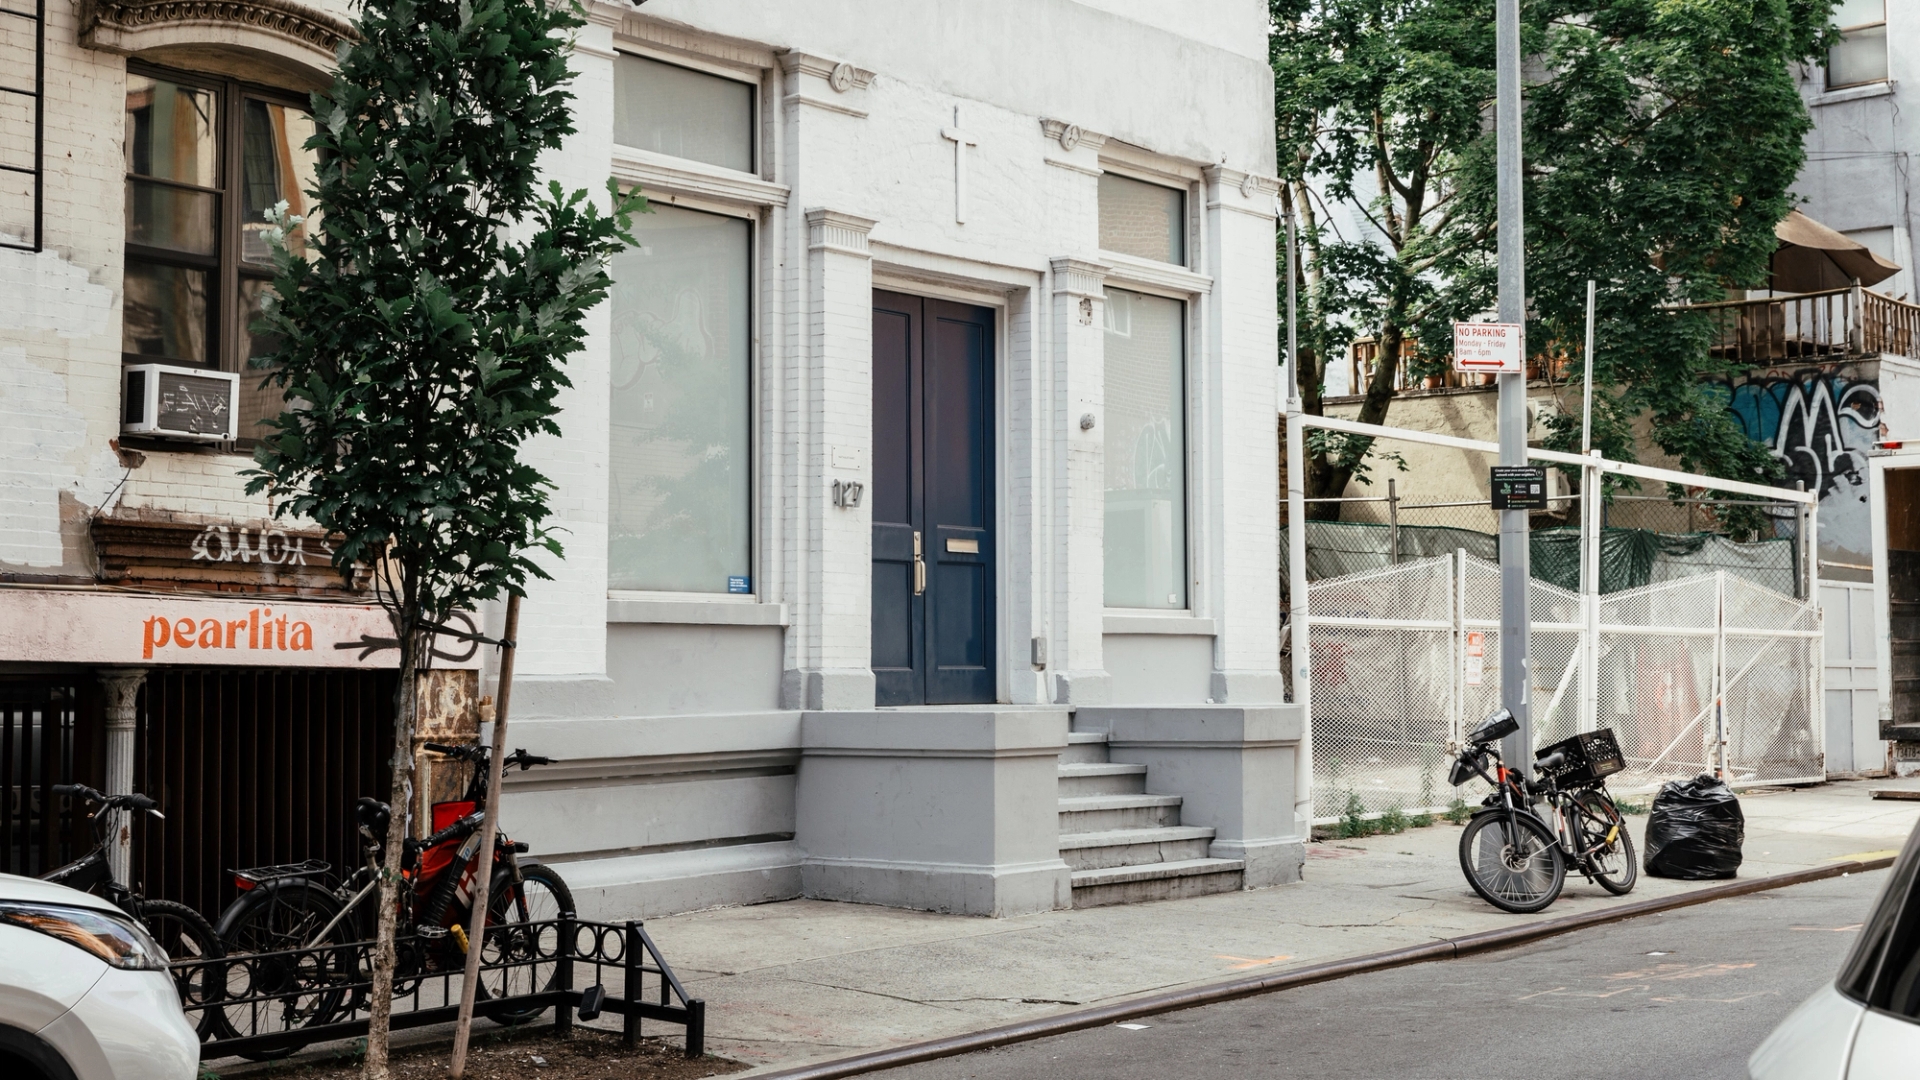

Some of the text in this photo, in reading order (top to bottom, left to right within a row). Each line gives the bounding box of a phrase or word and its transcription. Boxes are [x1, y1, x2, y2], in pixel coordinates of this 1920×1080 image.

[1459, 328, 1506, 337] NO PARKING
[1487, 340, 1506, 349] Friday
[1478, 349, 1491, 357] 6pm
[831, 478, 865, 508] 127
[142, 607, 313, 660] pearlita
